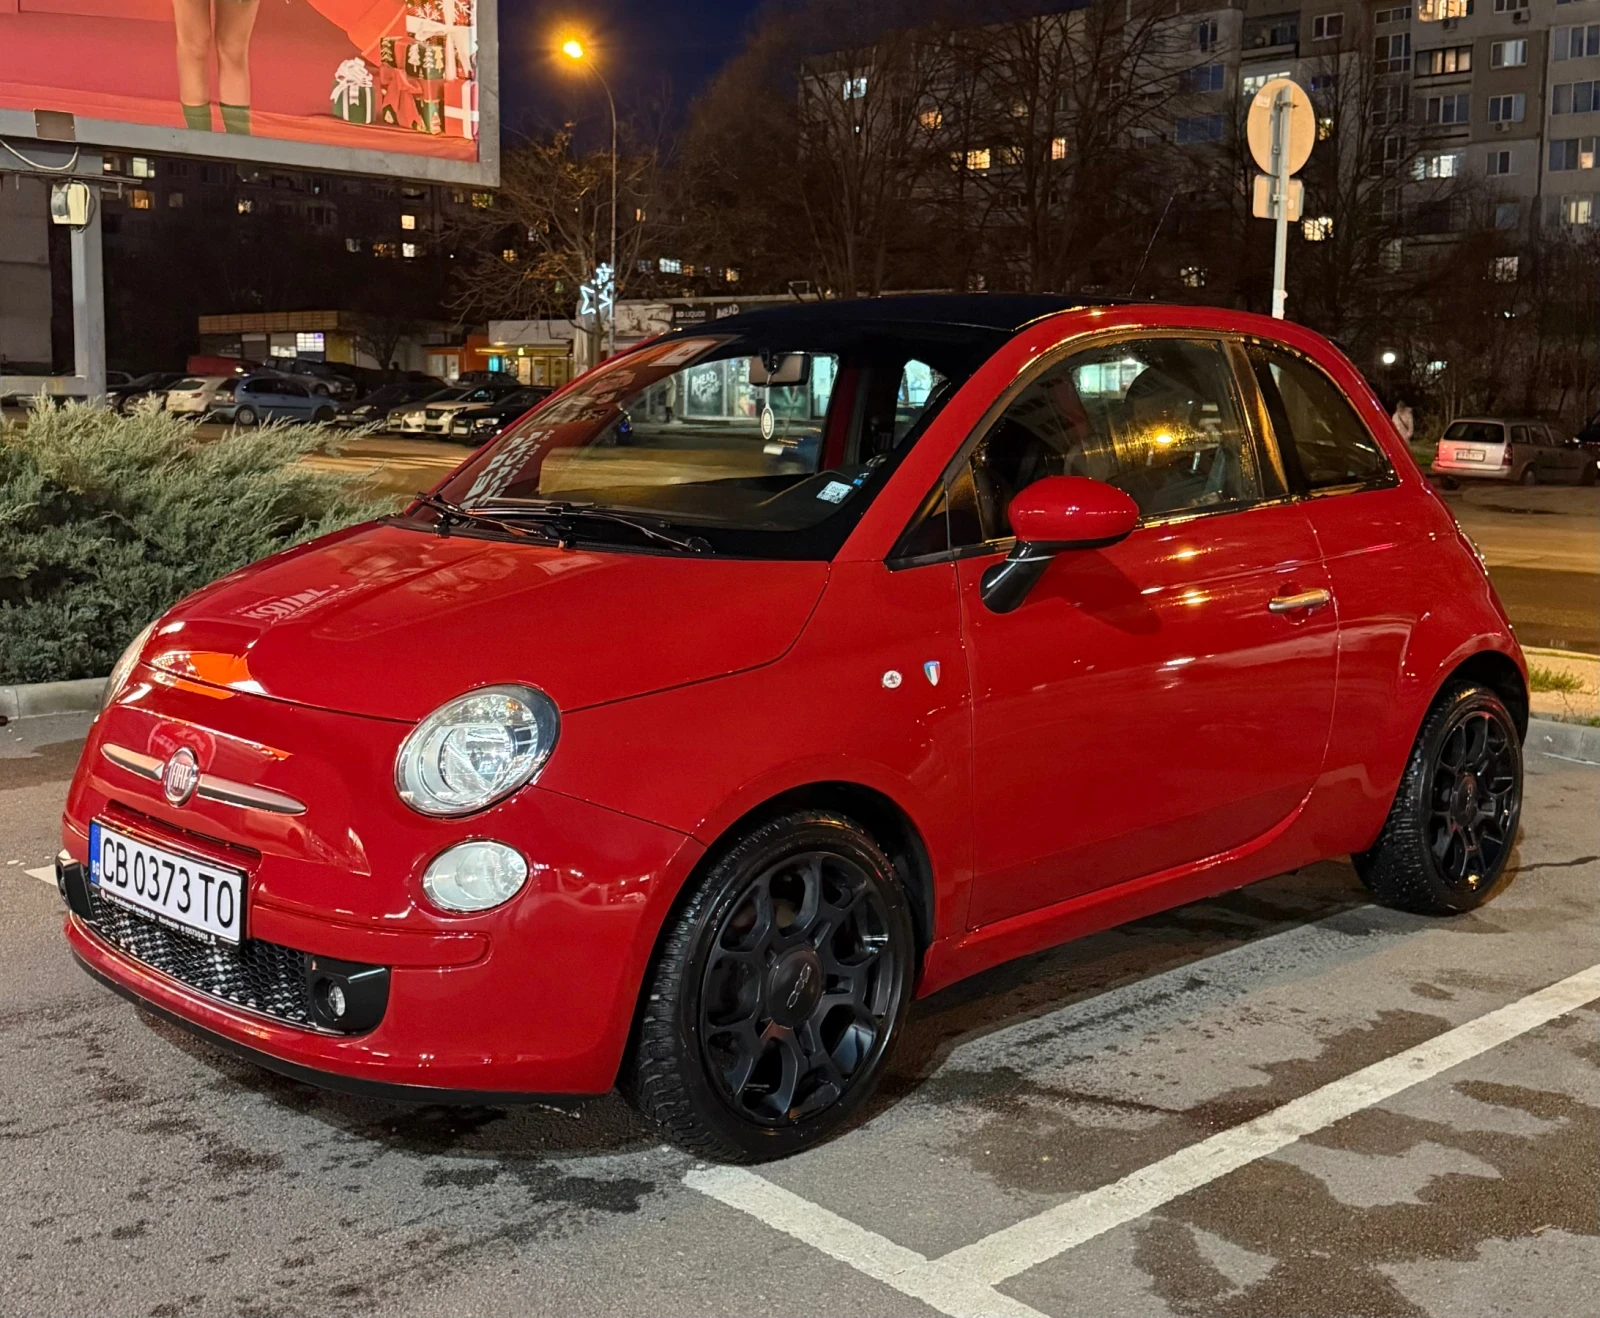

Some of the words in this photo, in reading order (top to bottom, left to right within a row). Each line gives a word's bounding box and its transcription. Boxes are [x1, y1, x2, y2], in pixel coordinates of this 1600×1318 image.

[167, 762, 192, 790] FIAT
[91, 859, 100, 876] BG
[102, 836, 128, 889] CB
[134, 850, 191, 914] 0373
[198, 871, 234, 929] TO
